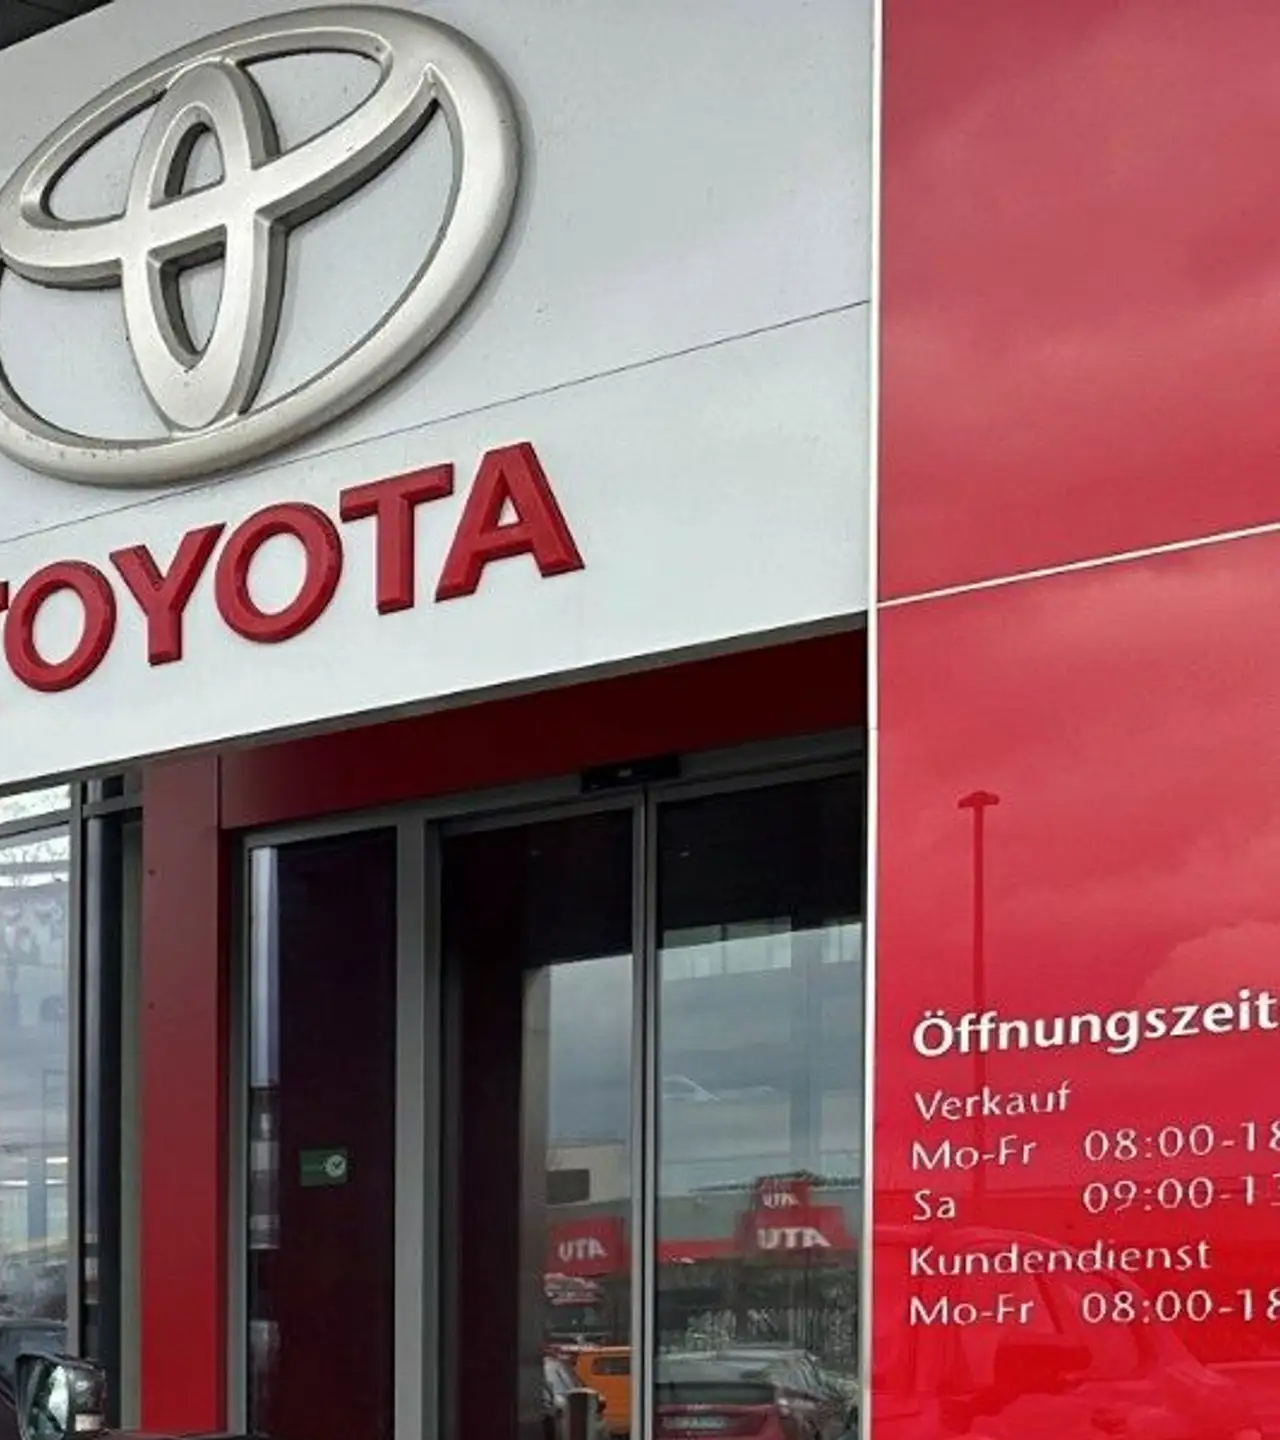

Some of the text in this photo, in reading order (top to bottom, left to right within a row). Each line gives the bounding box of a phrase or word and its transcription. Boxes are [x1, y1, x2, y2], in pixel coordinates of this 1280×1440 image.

[915, 1082, 1071, 1121] Verkauf
[912, 1135, 1037, 1170] Mo-Fr
[913, 1190, 956, 1221] Sa
[910, 1240, 1212, 1276] Kundendienst
[910, 1293, 1035, 1325] Mo-Fr
